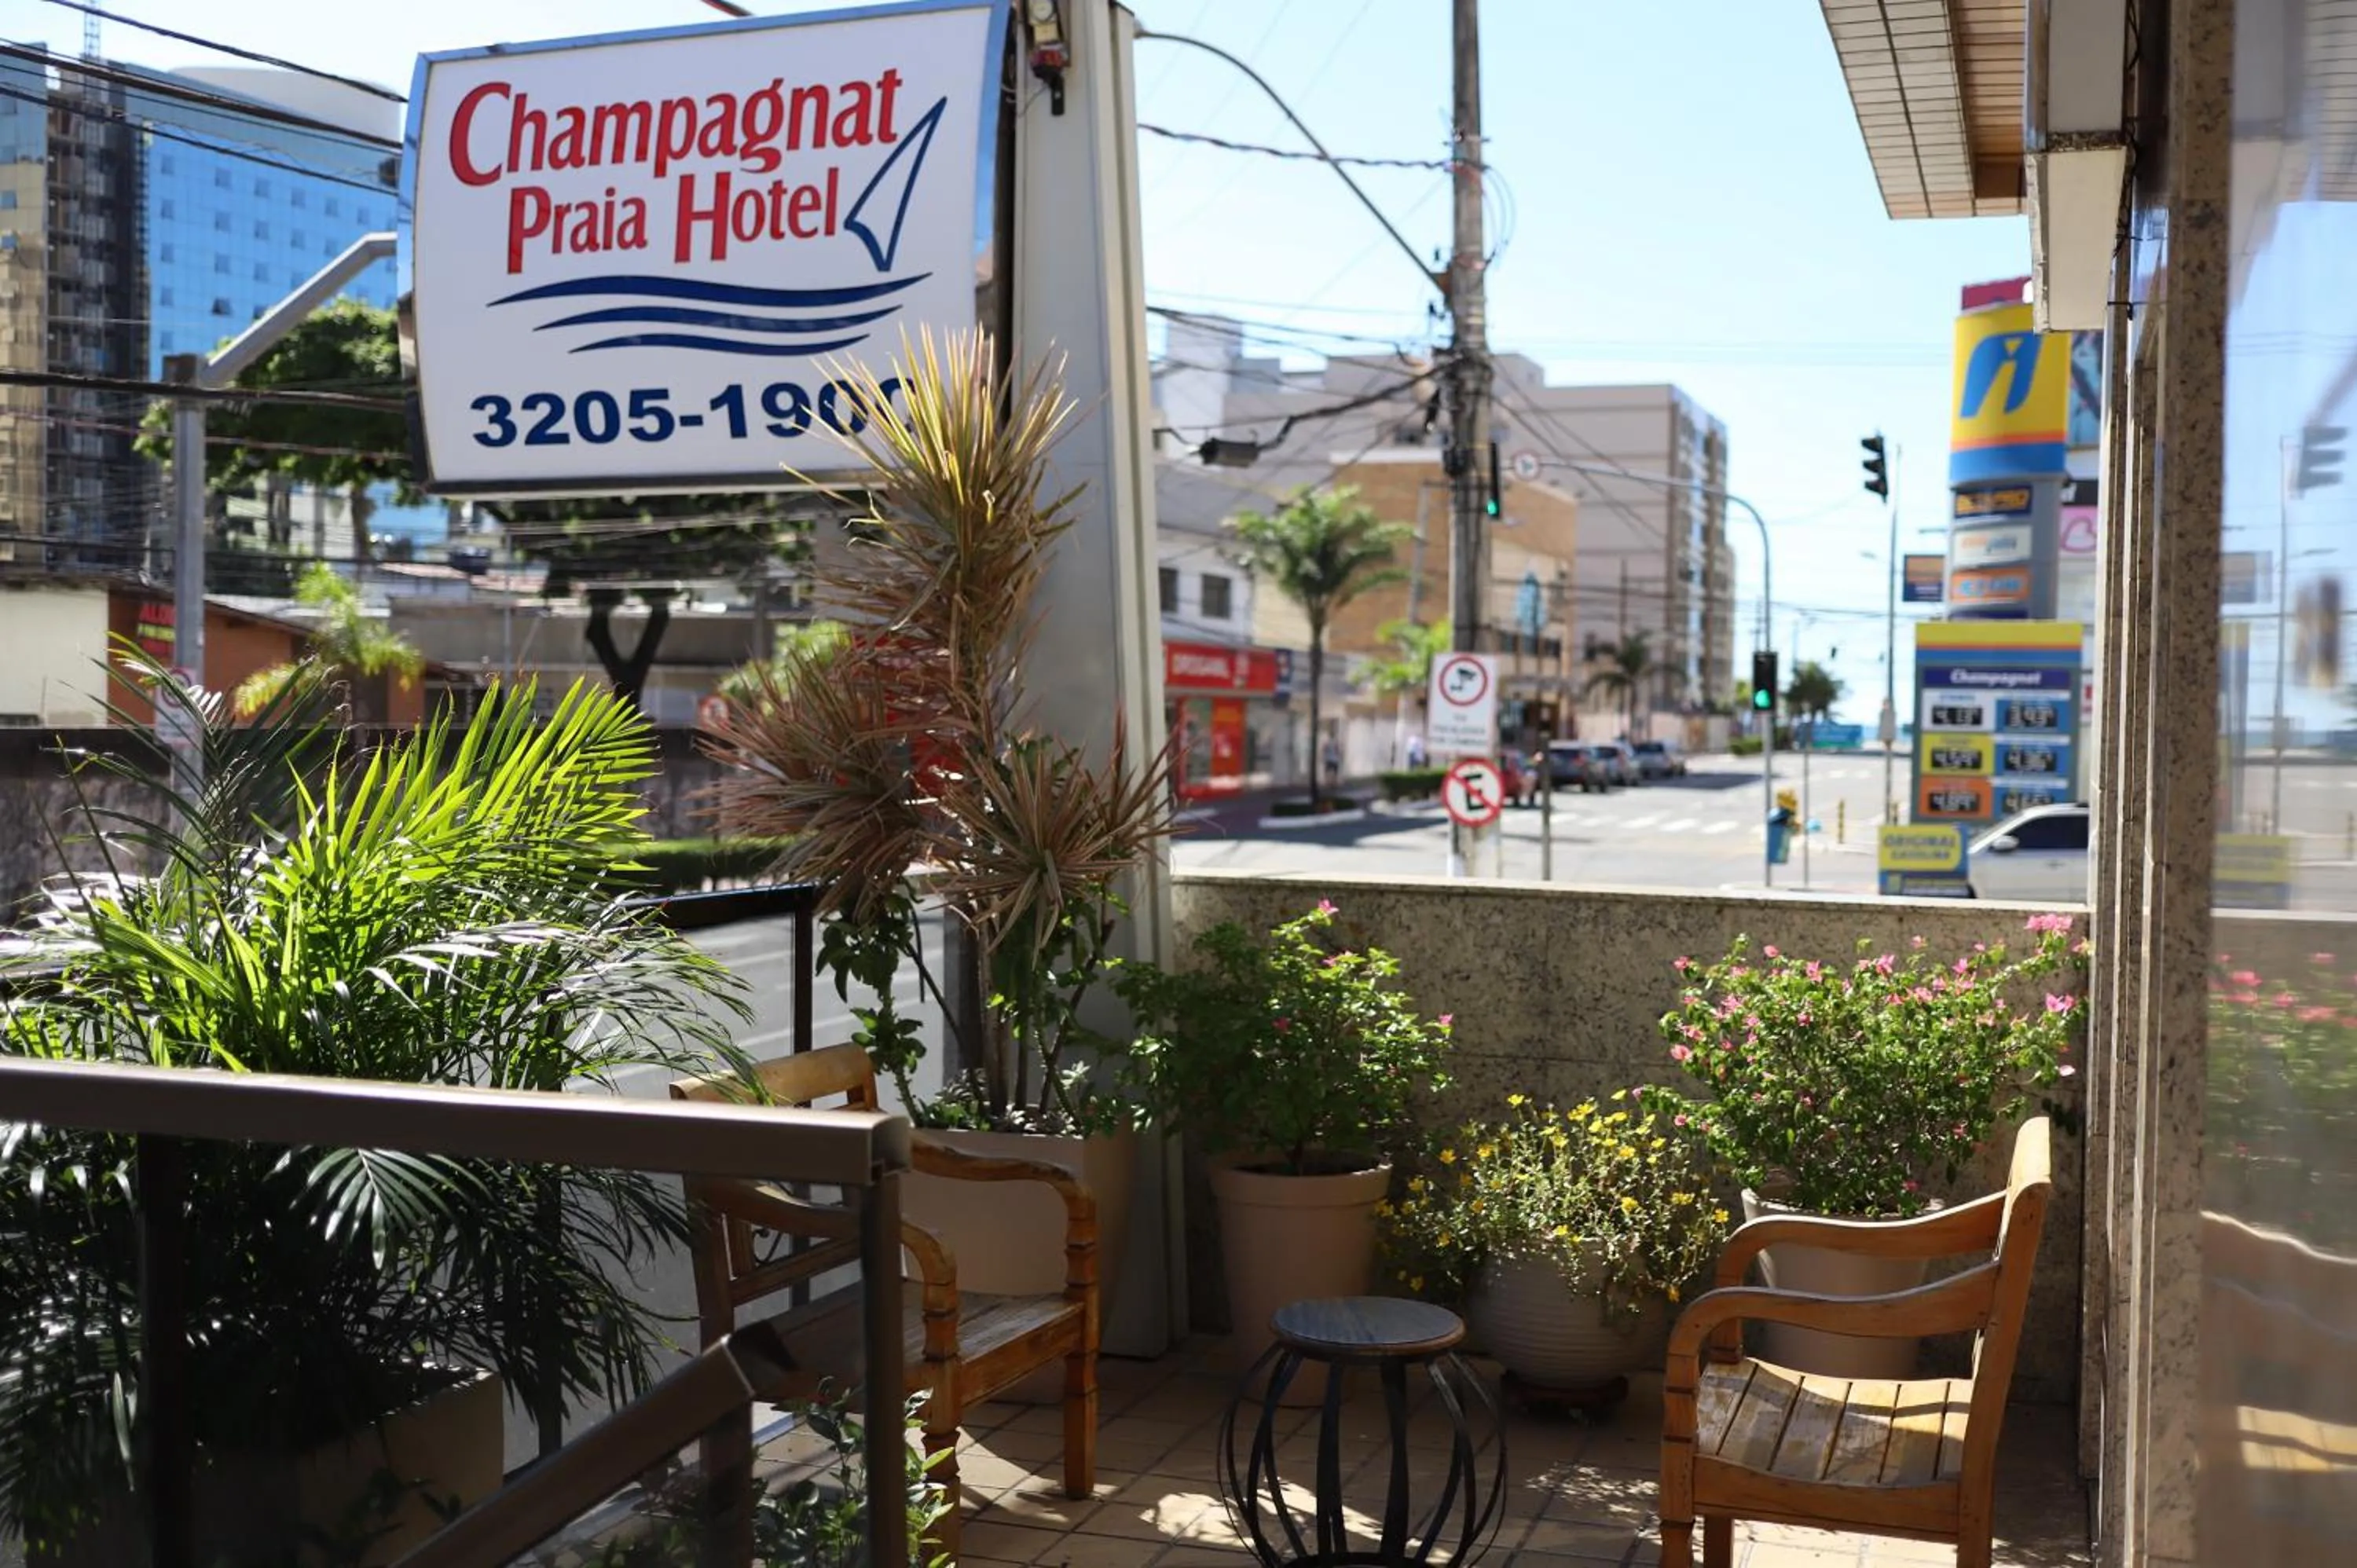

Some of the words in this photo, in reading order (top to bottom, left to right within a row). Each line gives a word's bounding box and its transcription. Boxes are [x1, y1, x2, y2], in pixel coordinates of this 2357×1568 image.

[449, 68, 903, 187] Champagnat
[507, 186, 647, 274] Praia
[674, 167, 840, 263] Hotel
[1950, 669, 2041, 687] Champagnat
